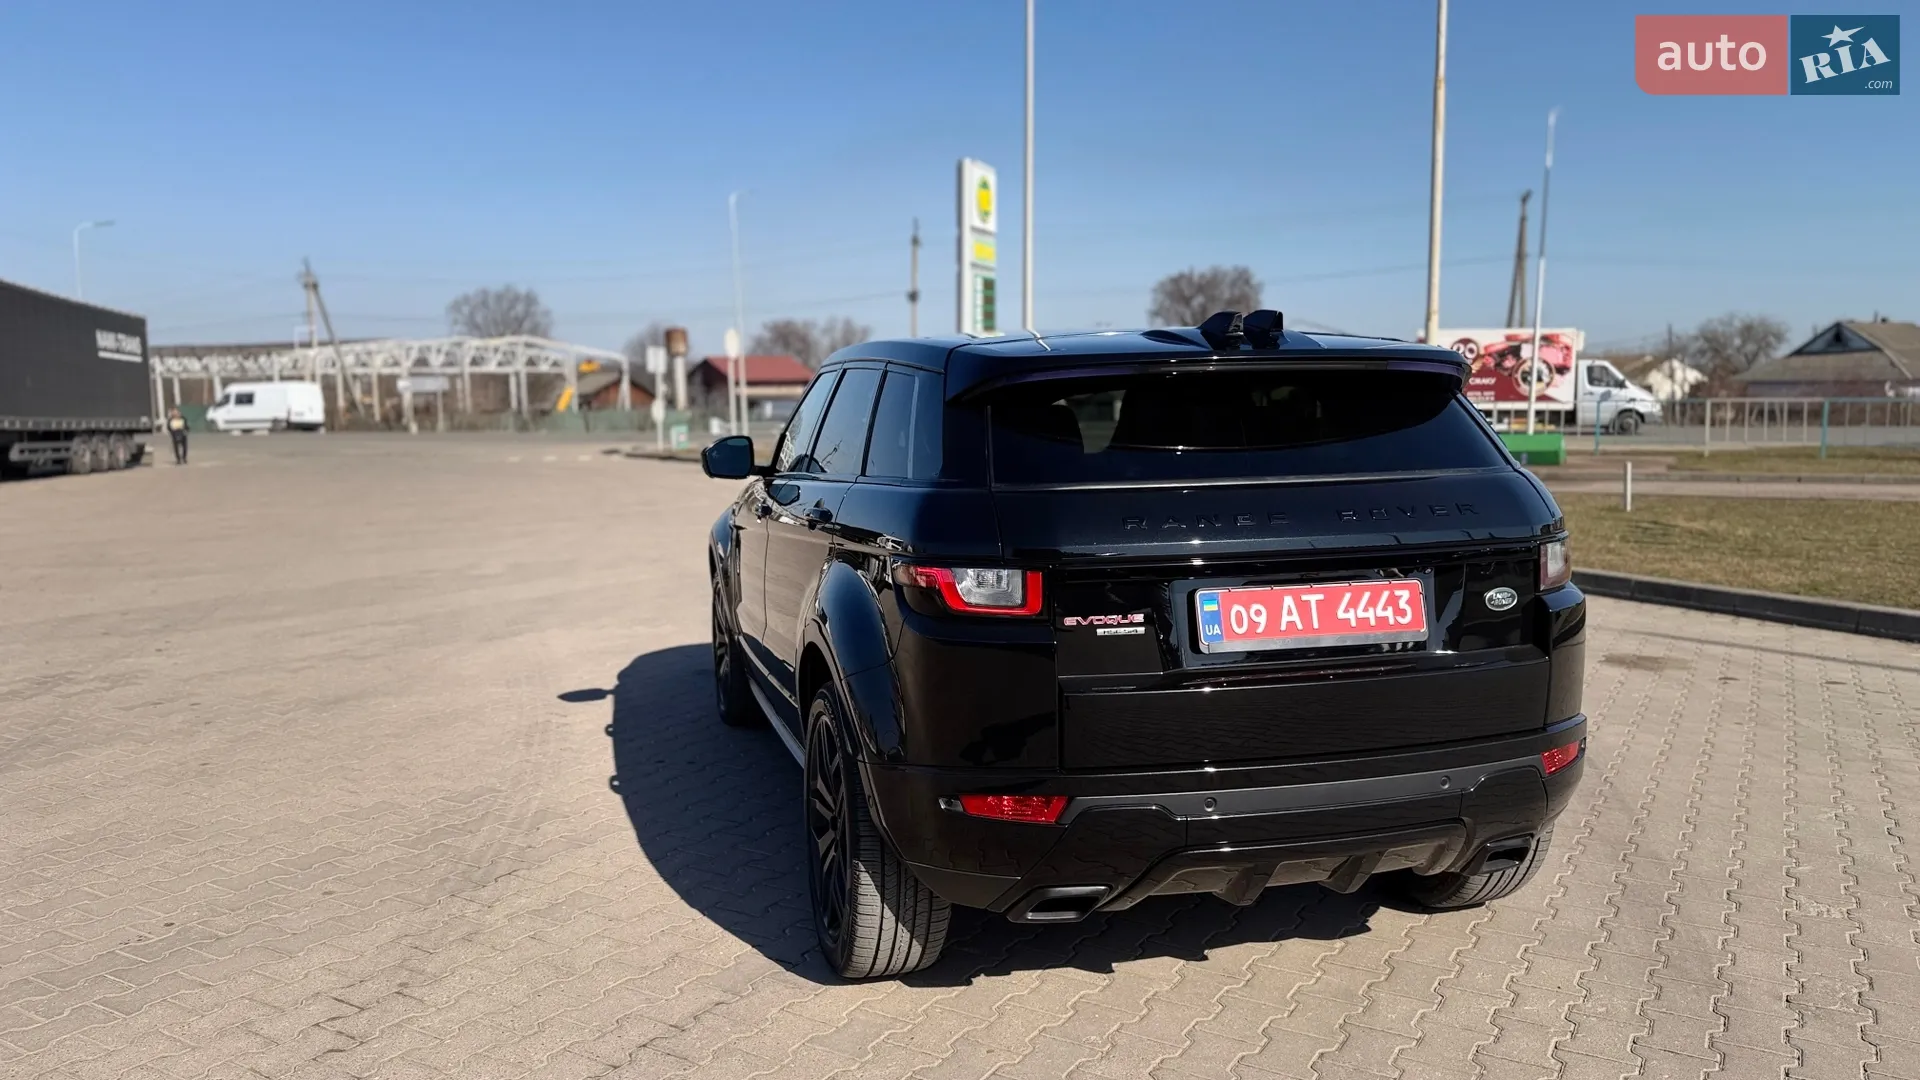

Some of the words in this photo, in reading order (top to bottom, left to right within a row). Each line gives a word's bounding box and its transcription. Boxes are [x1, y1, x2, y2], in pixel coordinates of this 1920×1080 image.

[1122, 512, 1290, 530] RANGE
[1336, 503, 1480, 523] ROVER
[1063, 613, 1145, 626] EVOQUE
[1229, 603, 1268, 635] 09
[1280, 594, 1325, 631] AT
[1337, 589, 1413, 628] 4443
[1205, 624, 1222, 636] UA
